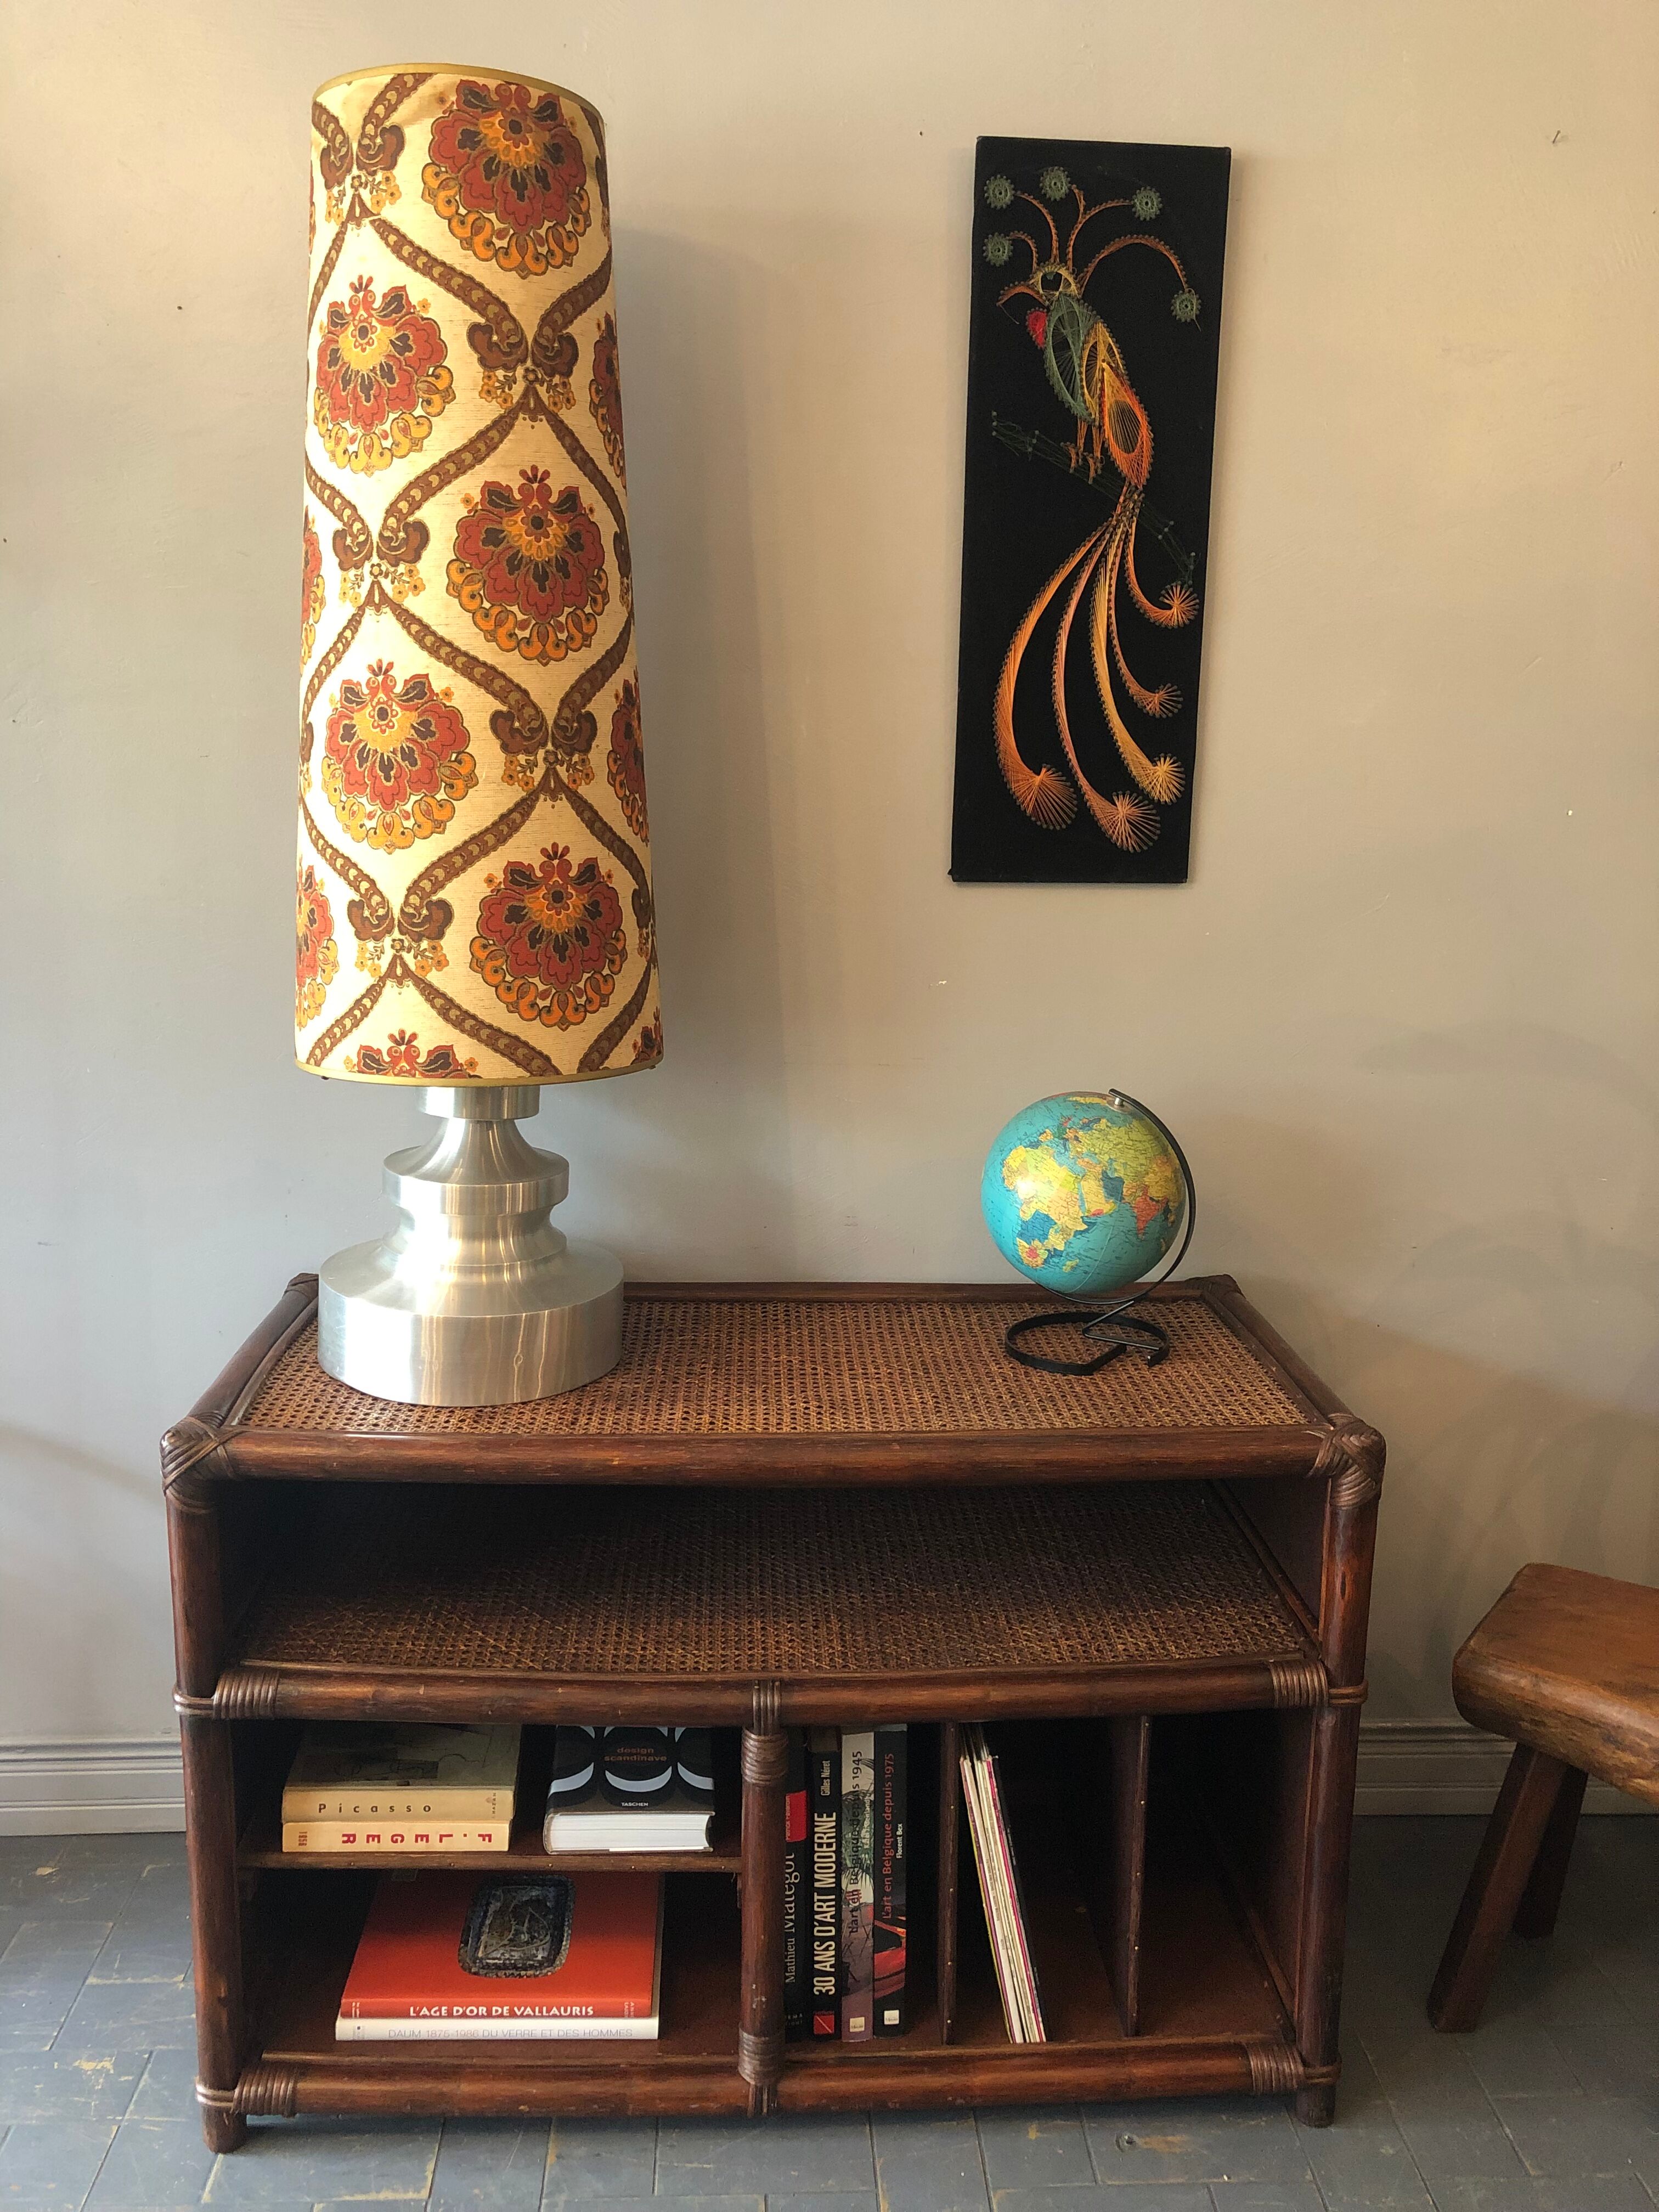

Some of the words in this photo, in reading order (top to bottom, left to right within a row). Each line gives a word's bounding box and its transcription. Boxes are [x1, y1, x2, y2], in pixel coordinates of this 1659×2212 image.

[821, 1760, 831, 1778] Néret
[852, 1751, 862, 1780] 1945
[884, 1753, 894, 1779] 1975
[821, 1779, 831, 1796] Gilles
[882, 1781, 894, 1820] depuis
[318, 1803, 432, 1813] Picasso
[814, 1812, 836, 1887] MODERNE
[849, 1831, 861, 1884] Belgique
[882, 1824, 894, 1875] Belgique
[884, 1877, 893, 1892] en
[814, 1892, 836, 1937] D'ART
[882, 1895, 891, 1919] L'art
[785, 1937, 795, 1983] Mathieu
[814, 1941, 836, 1972] ANS
[814, 1977, 836, 1995] 30
[410, 2006, 448, 2017] L'AGE
[453, 2006, 487, 2017] D'OR
[492, 2006, 509, 2016] DE
[514, 2006, 594, 2016] VALLAURIS
[388, 2029, 421, 2038] DAUM
[483, 2029, 497, 2038] DU
[502, 2029, 538, 2038] VERRE
[541, 2029, 554, 2038] ET
[558, 2029, 579, 2038] DES
[584, 2029, 633, 2038] HOMMES
